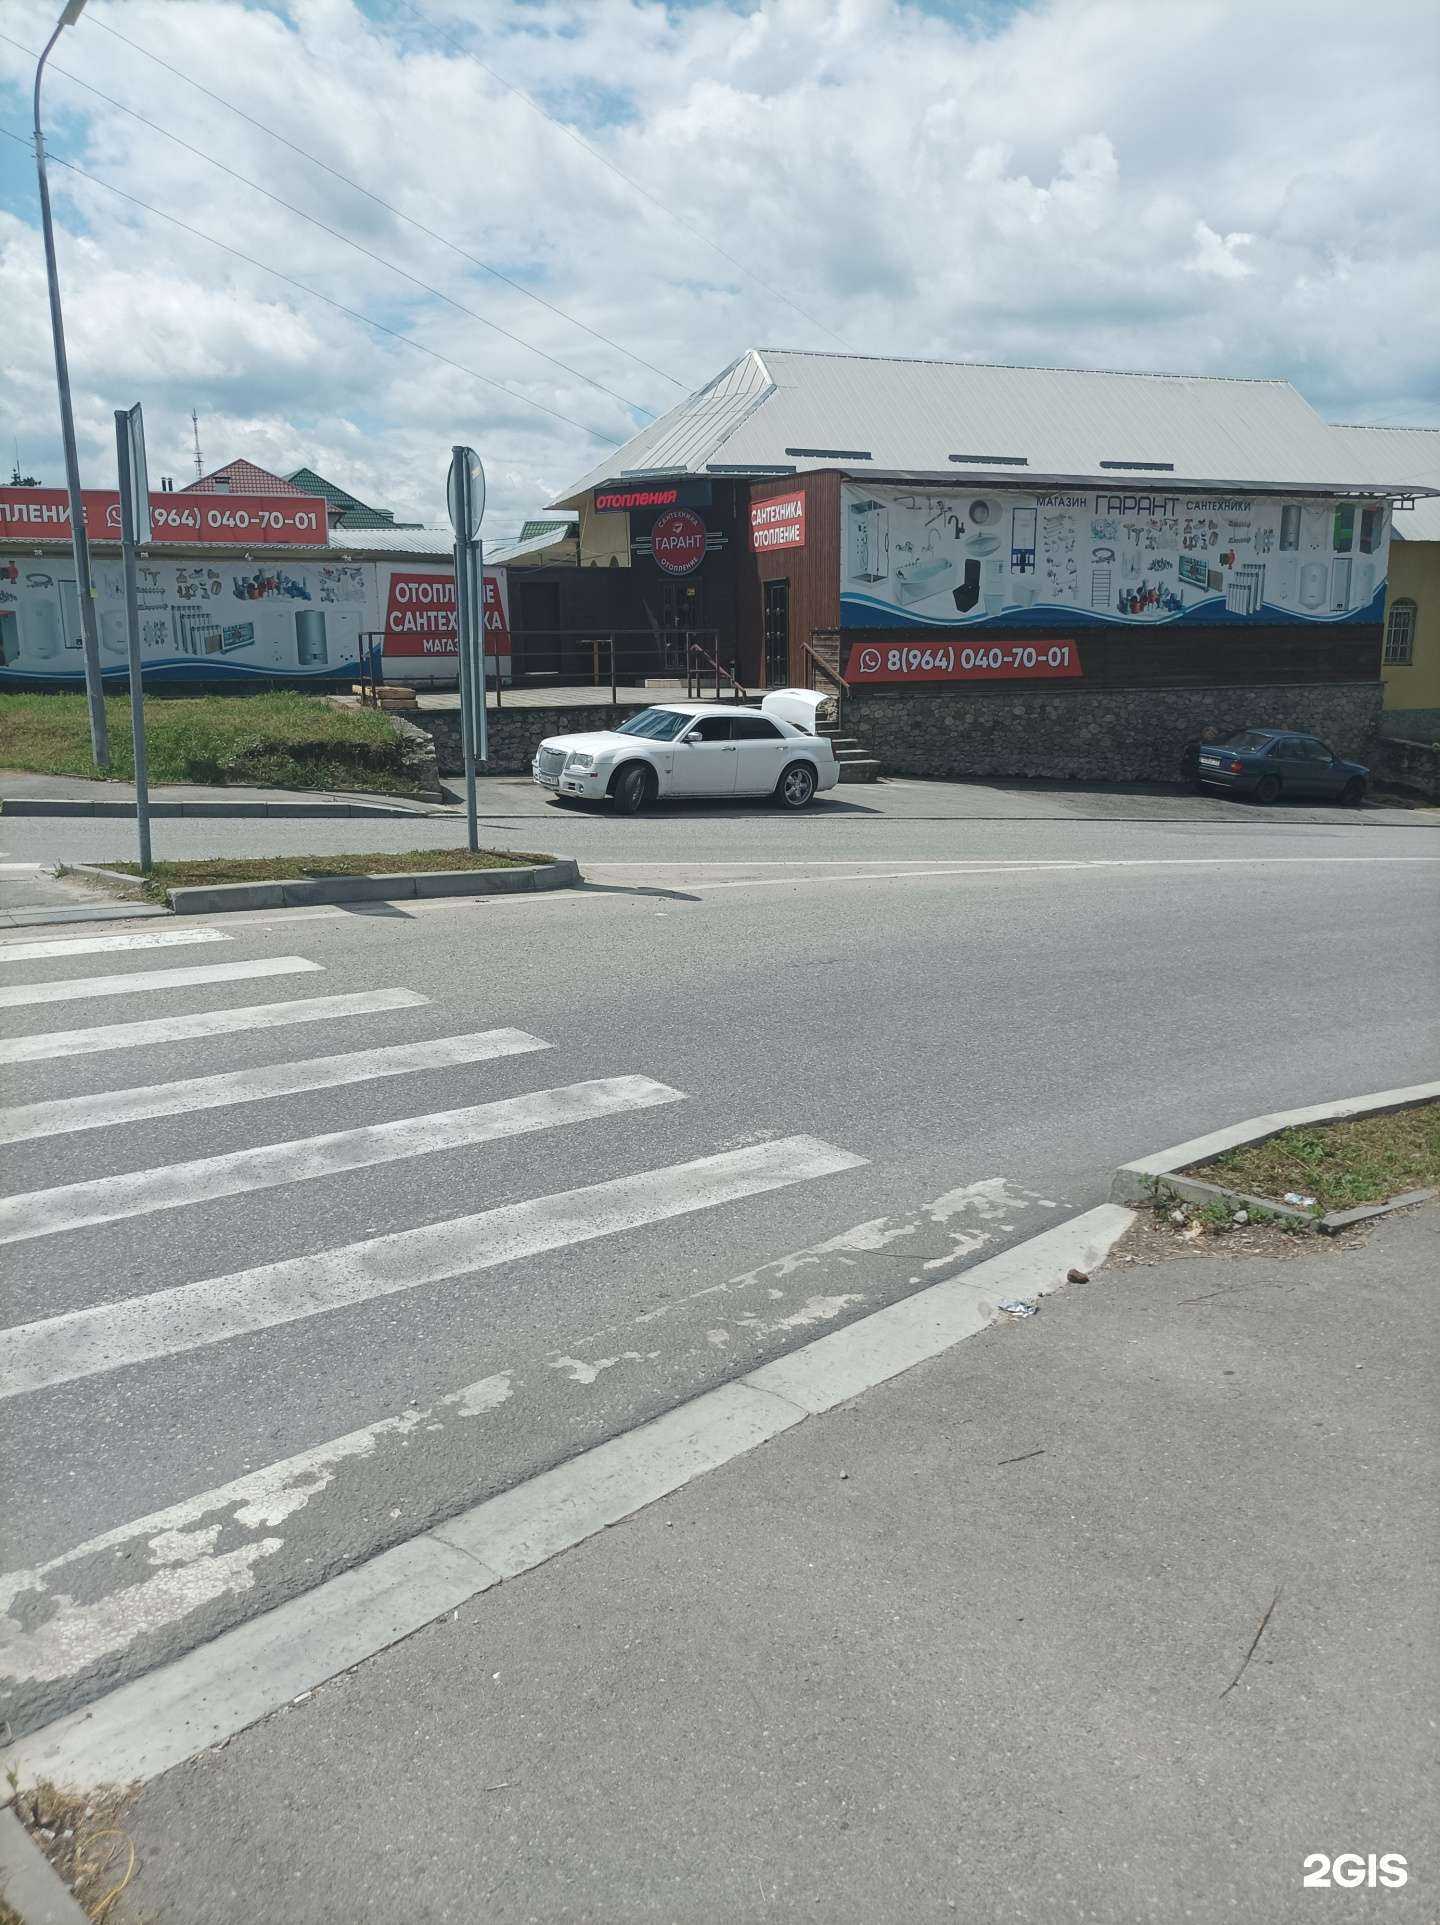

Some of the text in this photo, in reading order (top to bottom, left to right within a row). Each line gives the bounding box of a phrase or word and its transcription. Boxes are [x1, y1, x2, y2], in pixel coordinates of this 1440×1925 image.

[751, 500, 803, 526] САНТЕХНИКА
[1036, 495, 1251, 517] МАГАЗИН ГАРАНТ САНТЕХНИКИ
[149, 506, 201, 529] (964)
[207, 510, 317, 531] 040-70-01
[655, 535, 702, 551] ГАРАНТ
[753, 524, 800, 548] ОТОПЛЕНИЕ
[395, 582, 495, 604] ОТОПЛЕ
[389, 610, 503, 632] САНТЕХКА
[887, 647, 1070, 673] 8(964) 040-70-01
